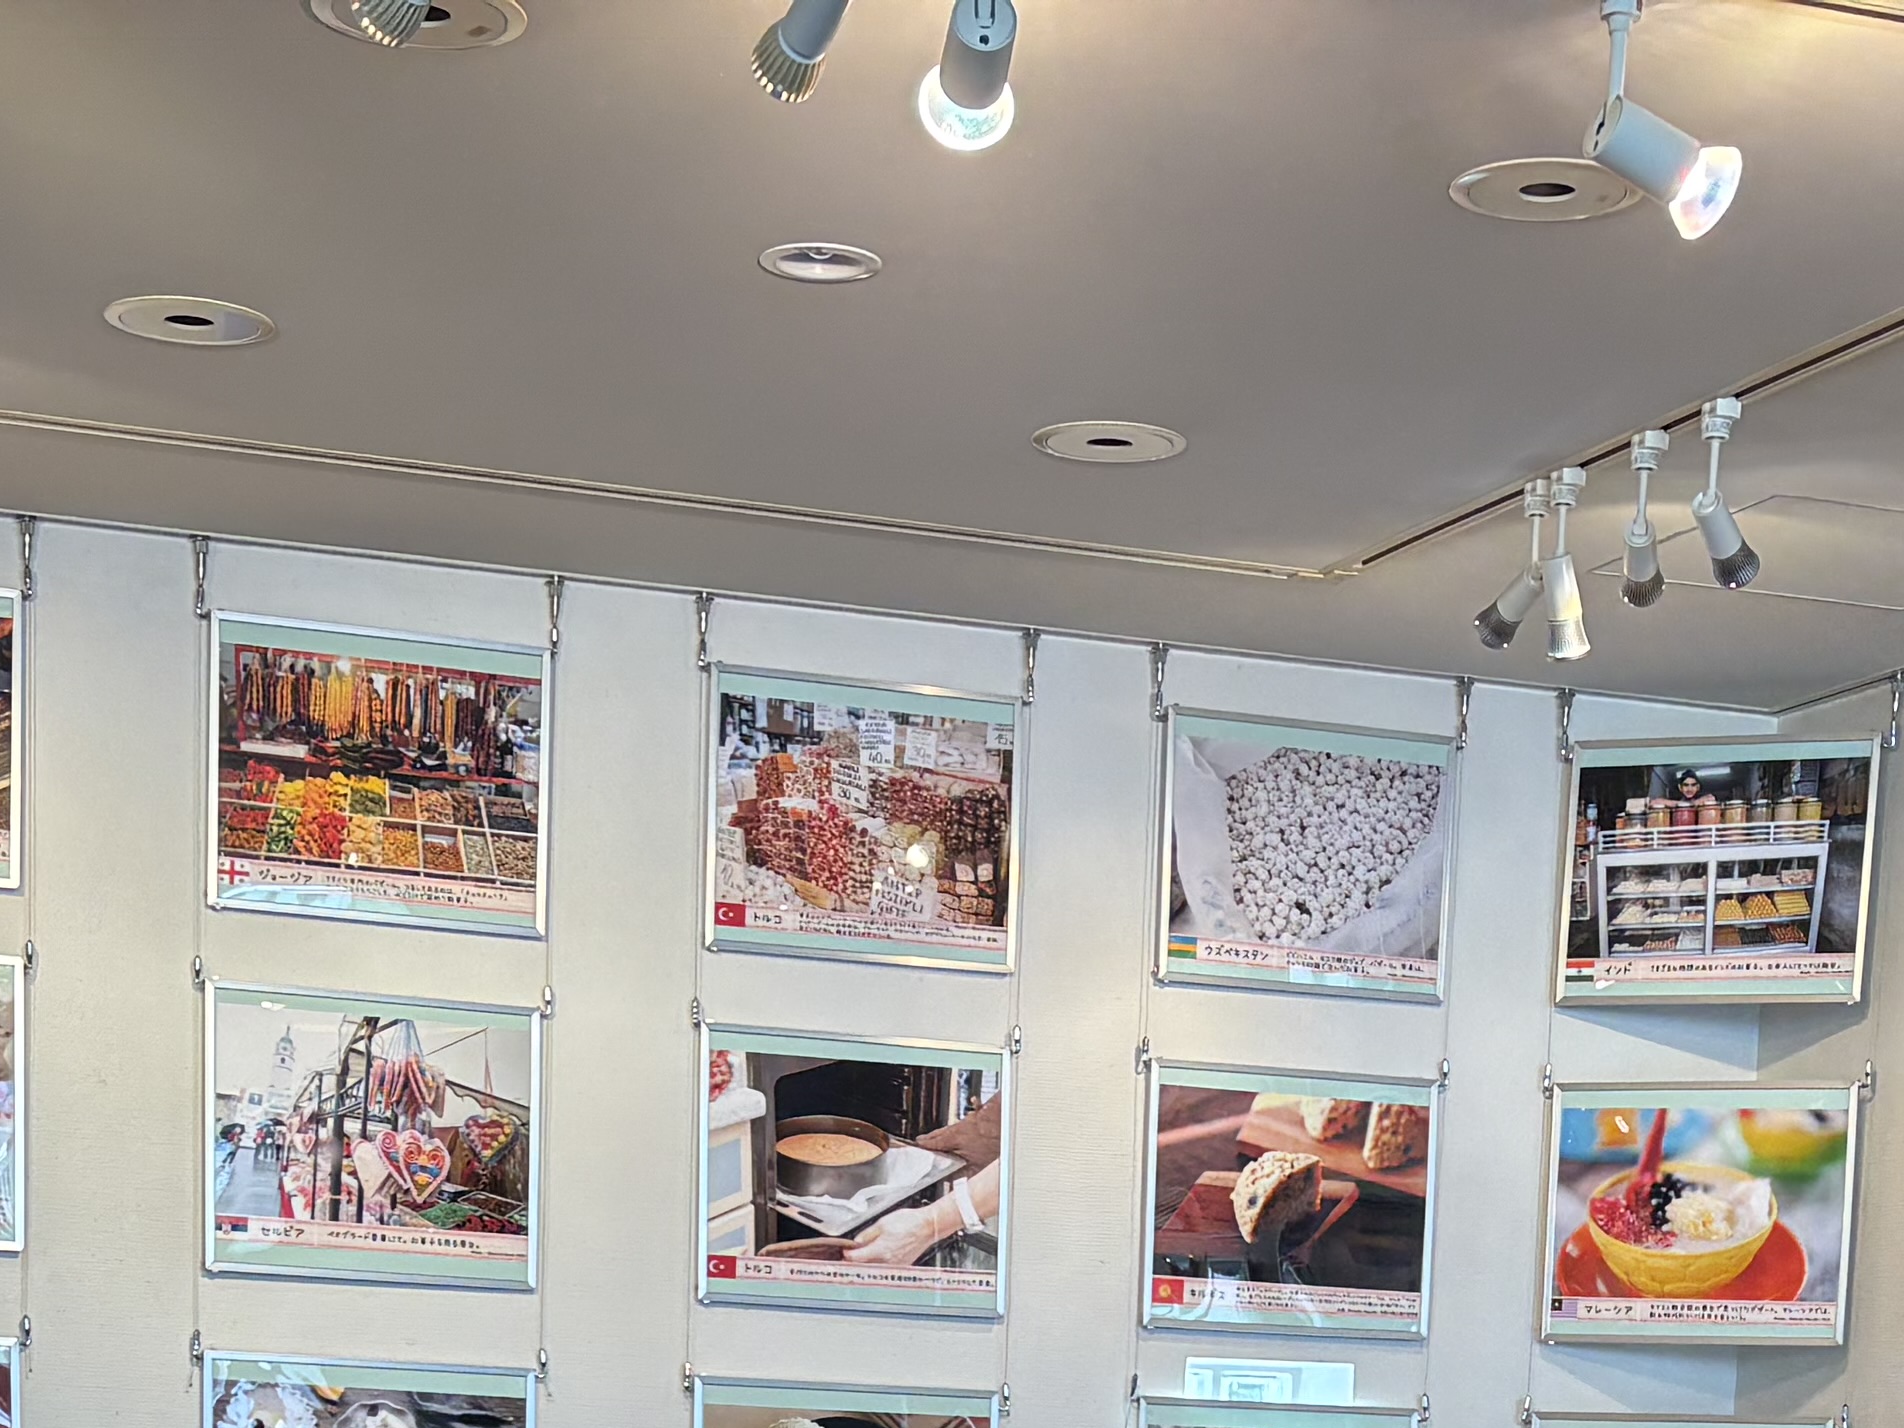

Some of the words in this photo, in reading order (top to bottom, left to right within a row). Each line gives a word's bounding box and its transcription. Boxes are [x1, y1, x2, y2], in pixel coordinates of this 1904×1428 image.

[258, 869, 313, 884] ジョージア
[1204, 945, 1269, 961] ウズベキスタン
[1604, 961, 1634, 976] インド
[743, 1263, 773, 1276] トルコ
[1584, 1304, 1634, 1318] マレーシア
